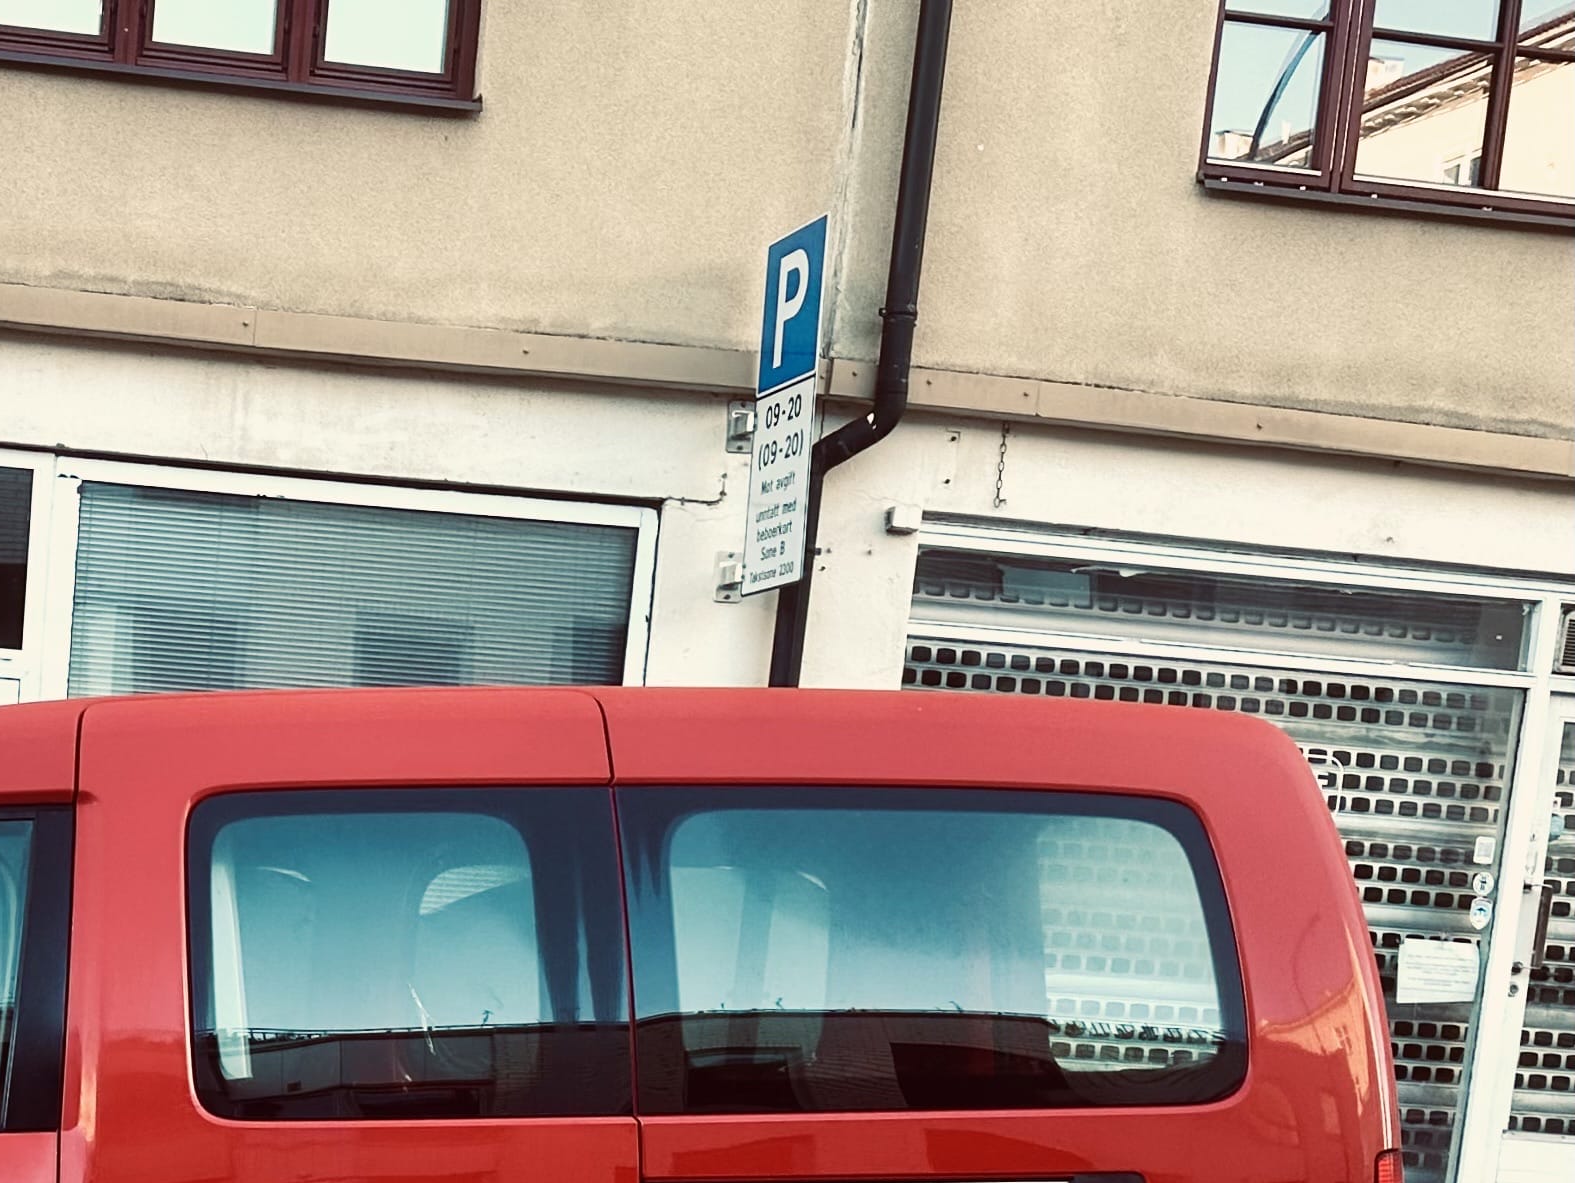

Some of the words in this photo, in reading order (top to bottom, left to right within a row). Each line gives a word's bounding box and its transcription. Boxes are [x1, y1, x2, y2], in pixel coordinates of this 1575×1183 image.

[773, 248, 810, 369] P
[765, 393, 802, 430] 09-20
[758, 428, 804, 472] (09-20)
[760, 480, 774, 495] Mot
[776, 470, 796, 491] avgift
[755, 503, 779, 523] unntatt
[782, 498, 797, 515] med
[760, 547, 777, 560] Sone
[779, 540, 786, 556] B
